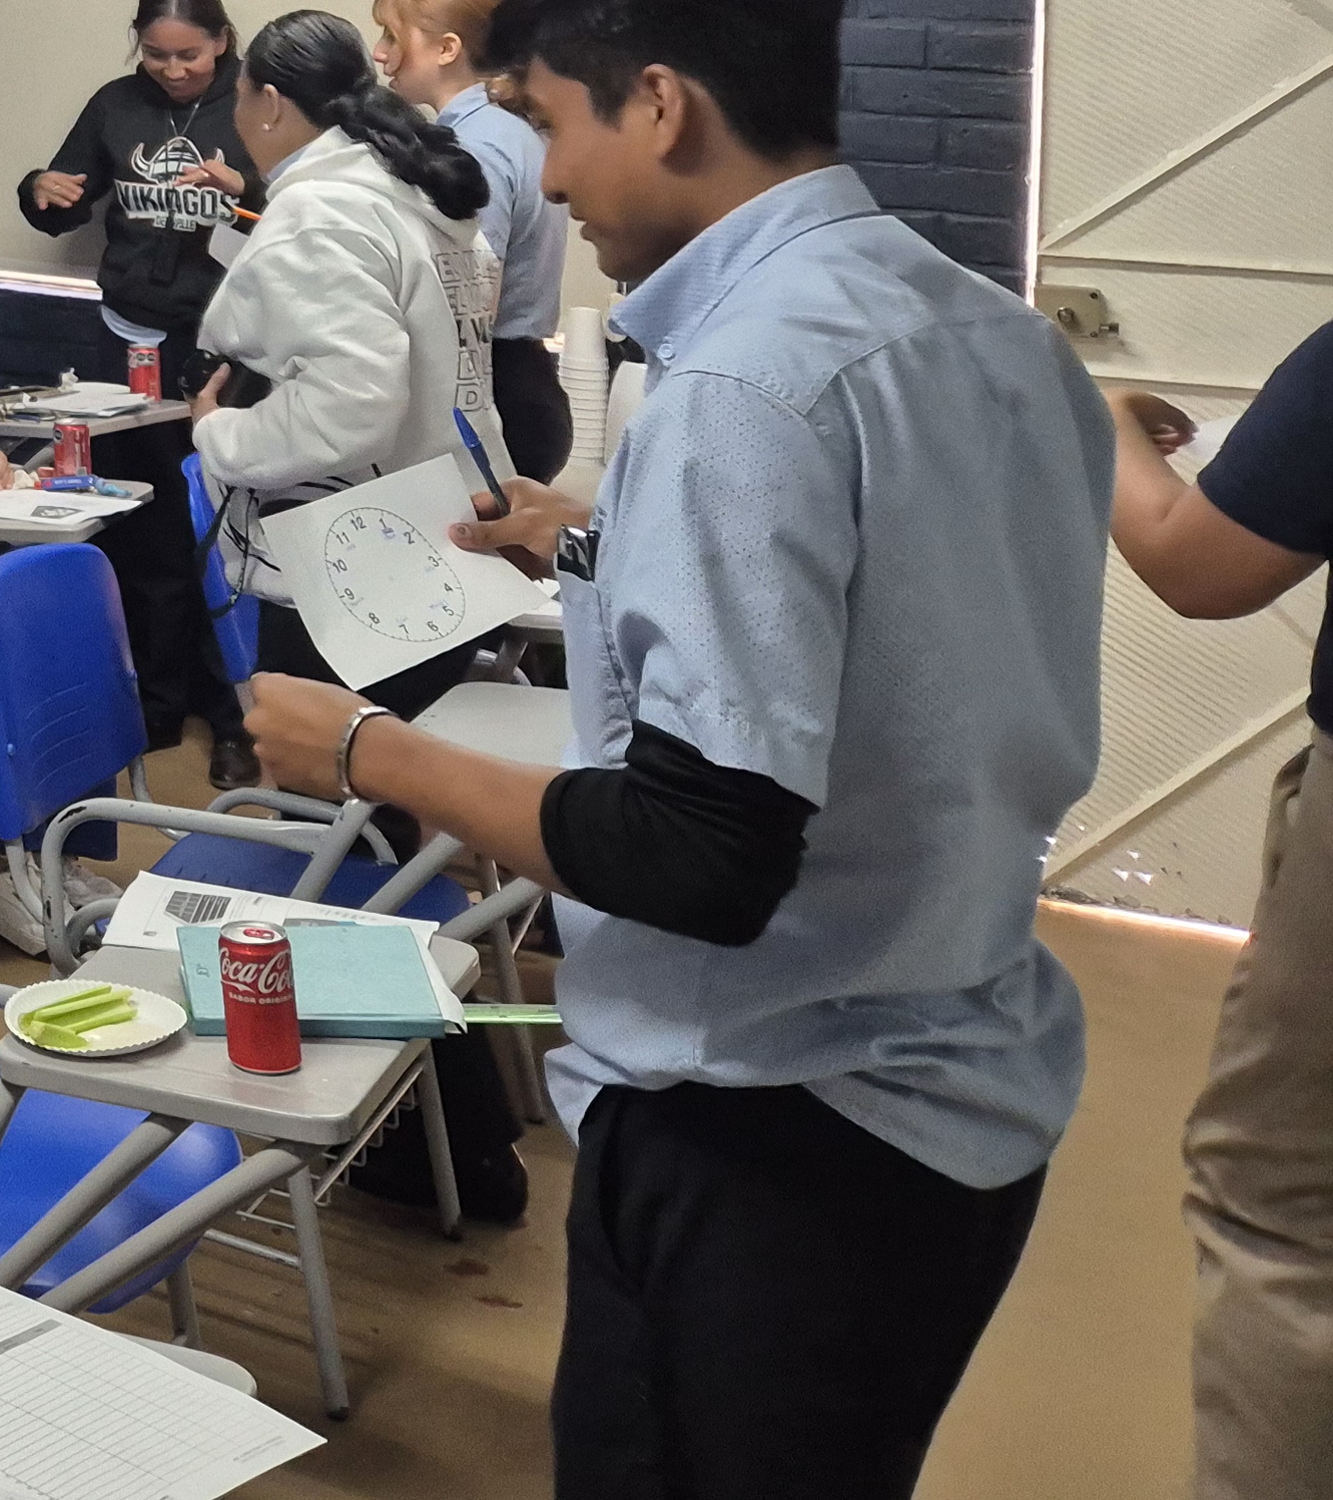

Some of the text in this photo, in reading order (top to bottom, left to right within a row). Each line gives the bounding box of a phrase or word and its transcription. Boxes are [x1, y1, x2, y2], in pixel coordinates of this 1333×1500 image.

[351, 516, 367, 531] 12
[336, 531, 350, 545] 11
[403, 531, 416, 545] 2
[333, 559, 348, 574] 10
[427, 555, 440, 568] 3
[343, 587, 355, 600] 9
[443, 583, 454, 593] 4
[442, 605, 455, 617] 5
[368, 612, 380, 625] 8
[399, 623, 409, 634] 7
[426, 620, 439, 632] 6
[220, 947, 291, 994] Coca-Co
